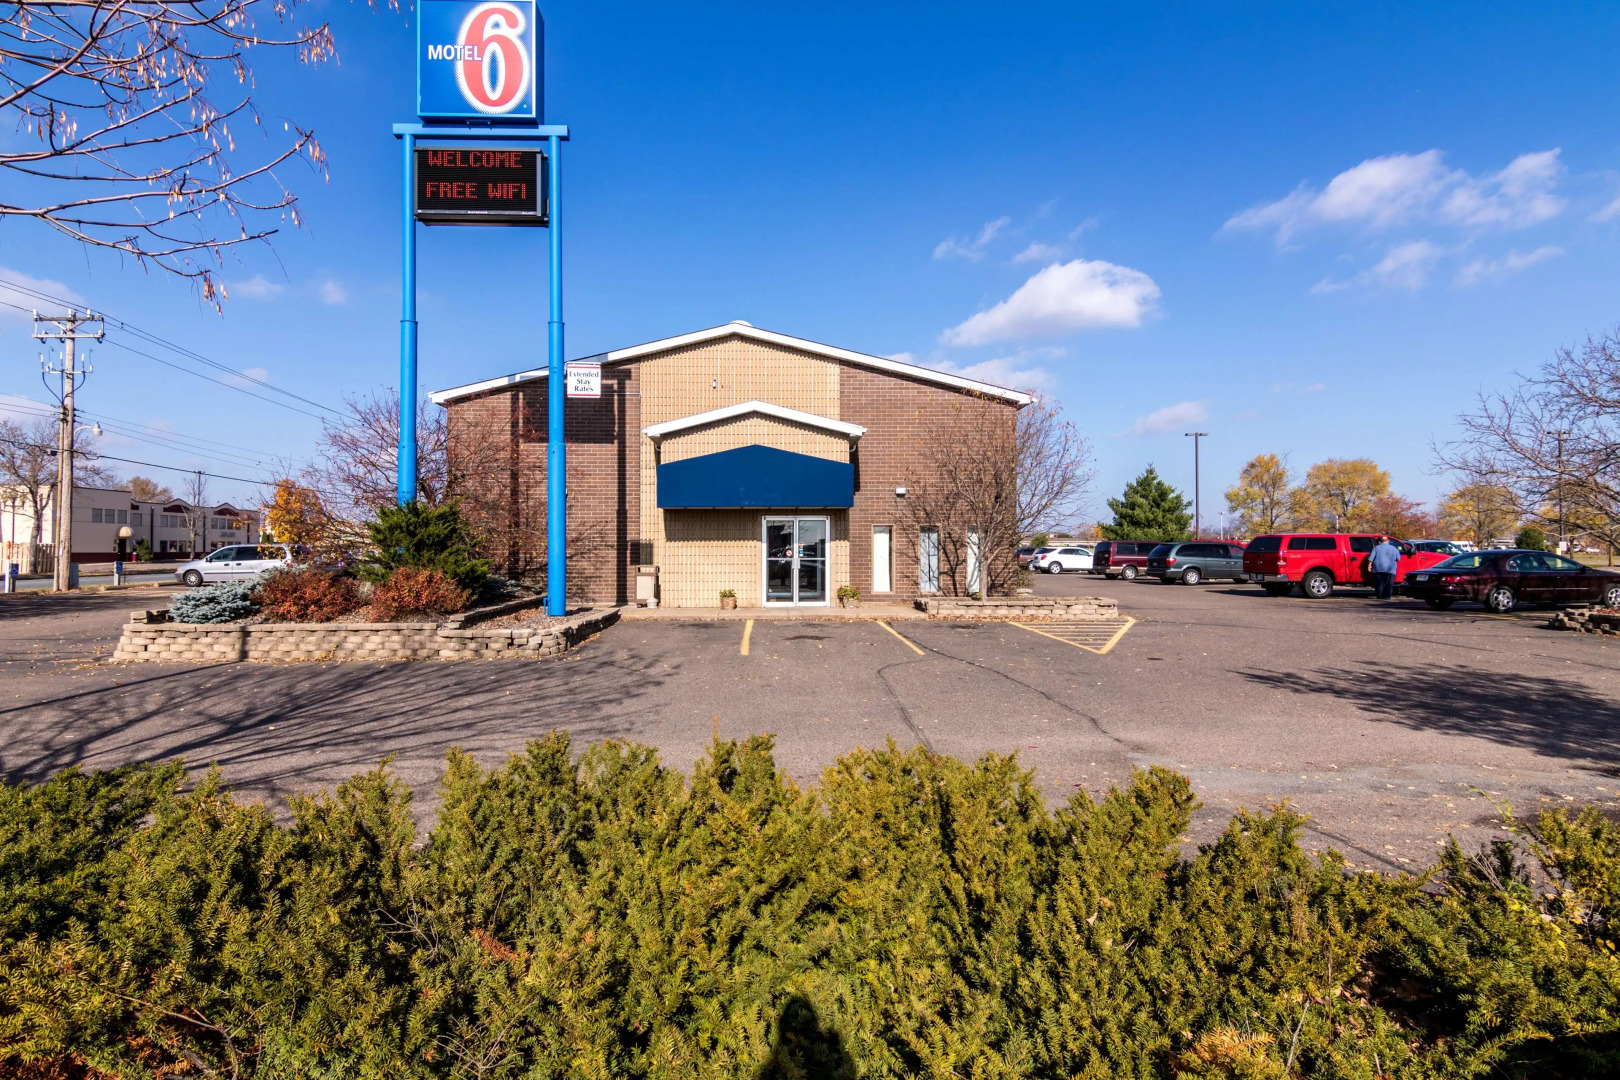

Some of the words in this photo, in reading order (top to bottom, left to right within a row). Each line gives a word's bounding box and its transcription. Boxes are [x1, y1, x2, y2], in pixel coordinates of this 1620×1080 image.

[428, 45, 482, 60] MOTEL
[461, 5, 525, 109] 6
[428, 151, 522, 167] WELCOME
[426, 182, 478, 198] FREE
[488, 183, 526, 199] WIFI
[576, 378, 591, 386] Stay
